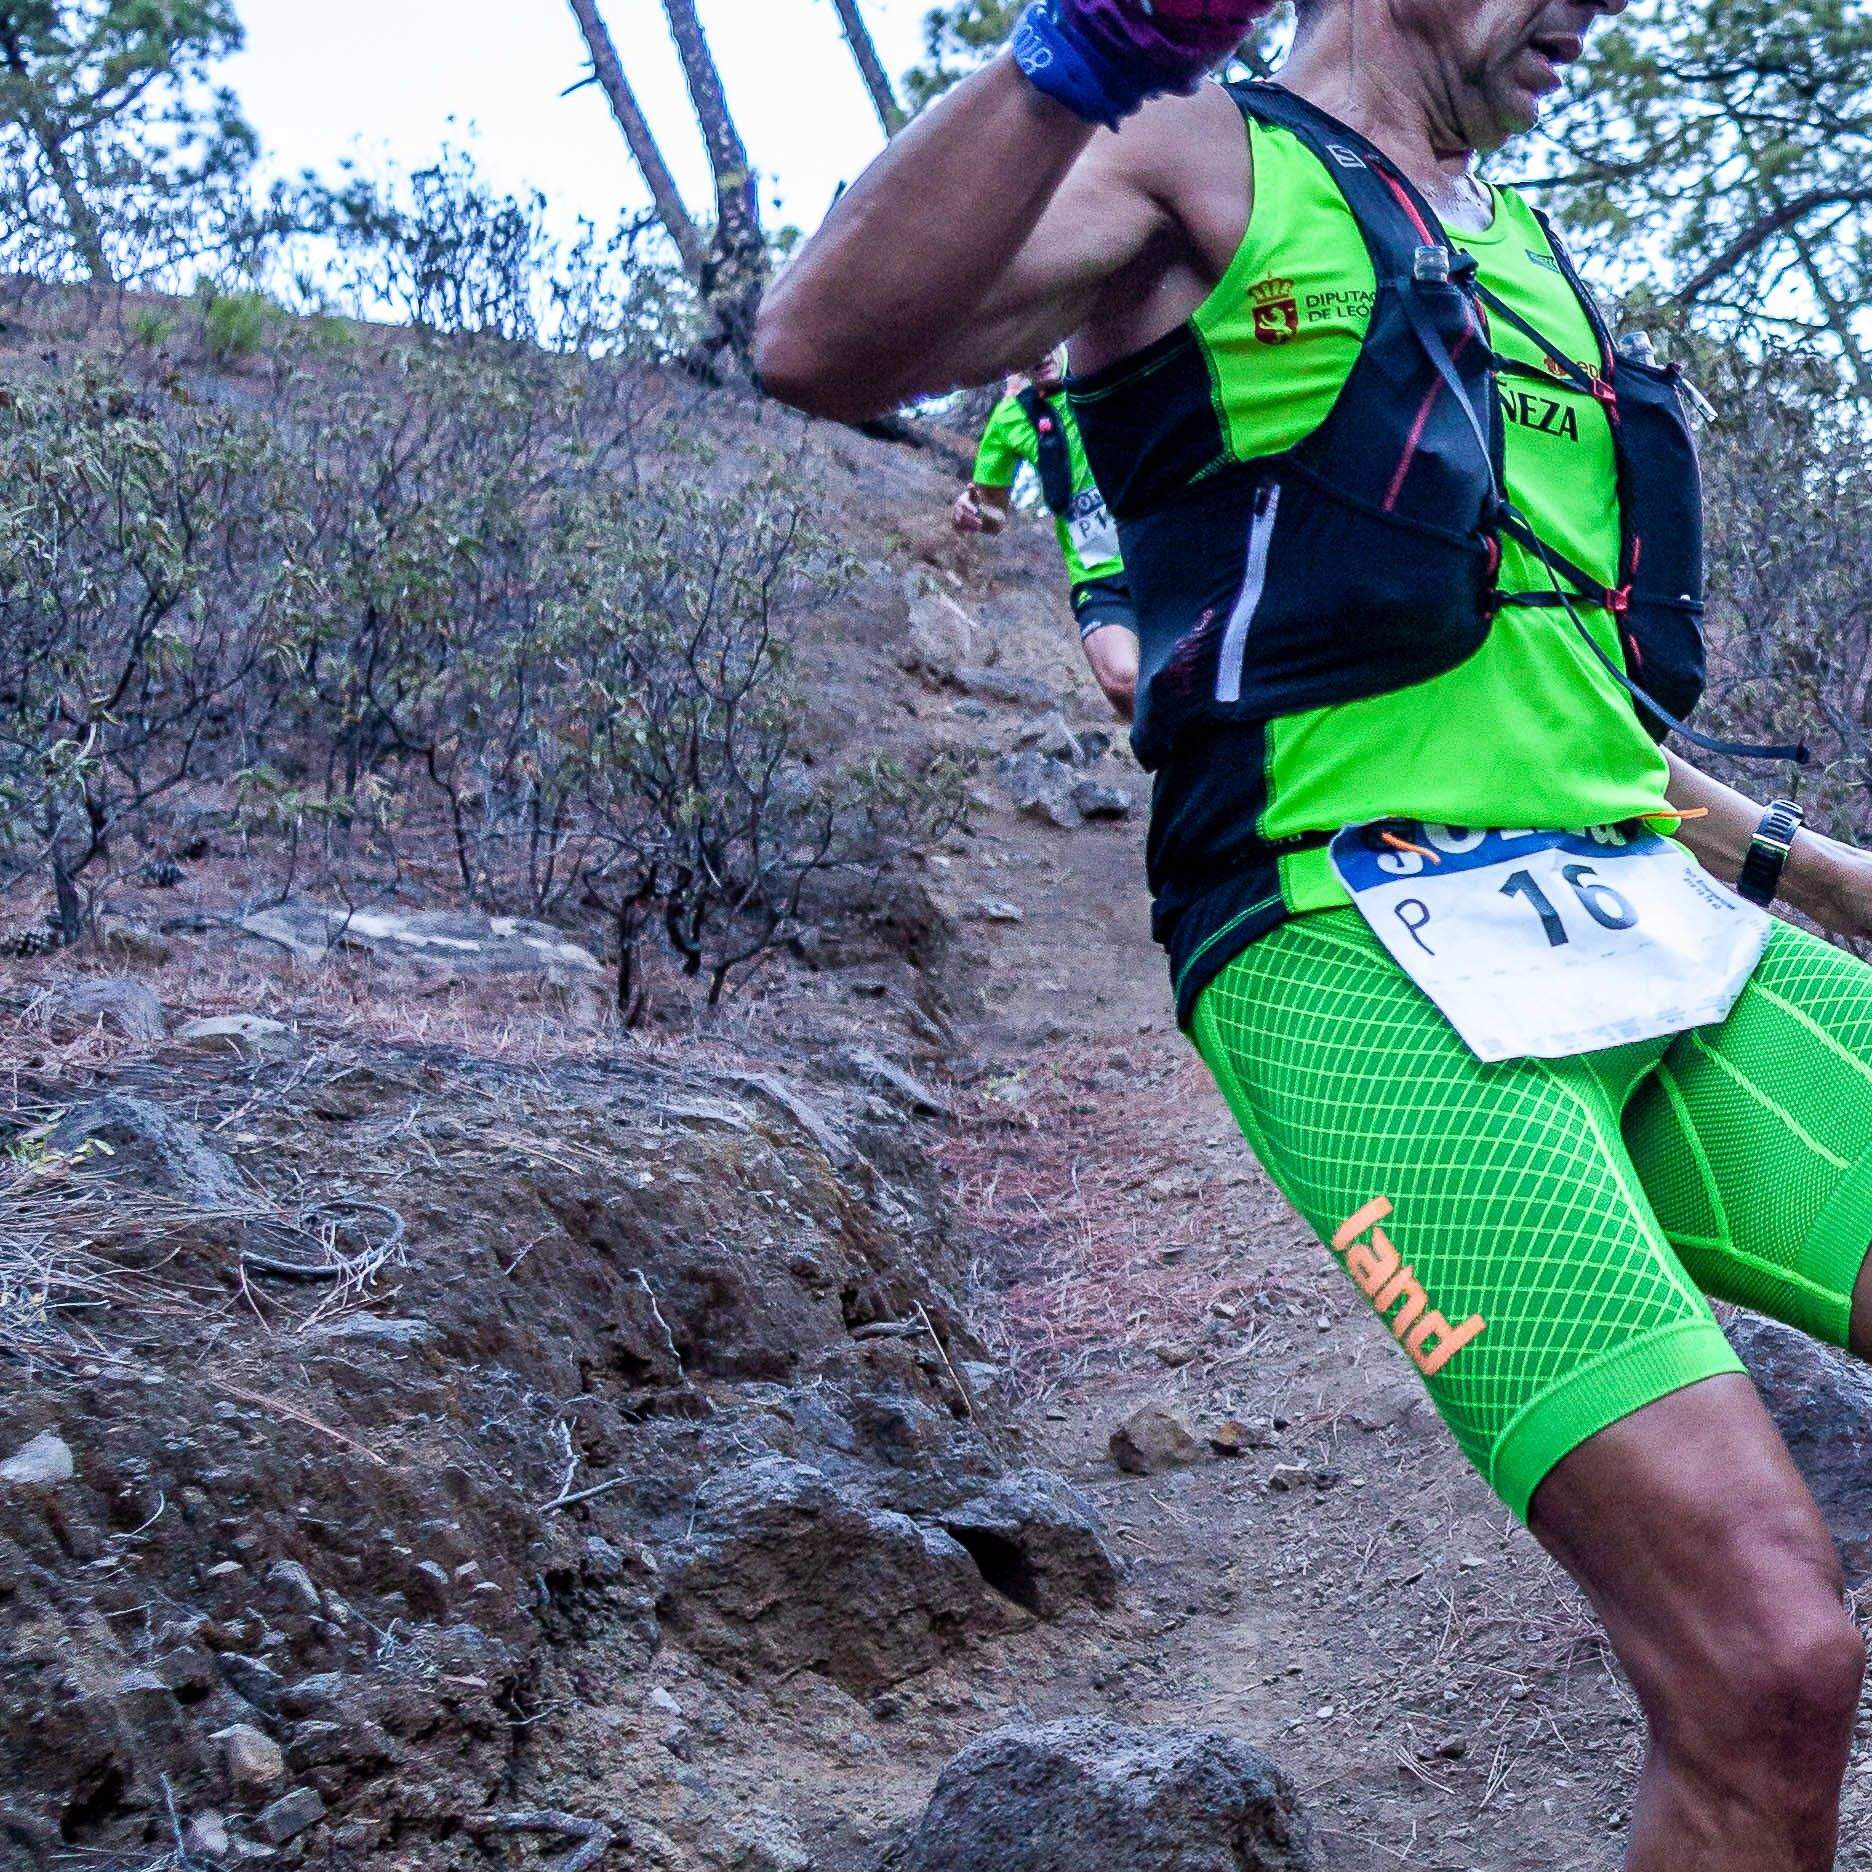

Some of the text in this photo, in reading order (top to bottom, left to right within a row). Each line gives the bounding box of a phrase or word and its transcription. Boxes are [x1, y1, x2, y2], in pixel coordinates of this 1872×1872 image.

[1307, 309, 1331, 322] DE
[1394, 898, 1435, 956] P
[1498, 864, 1639, 954] 16
[1331, 1195, 1488, 1376] land
